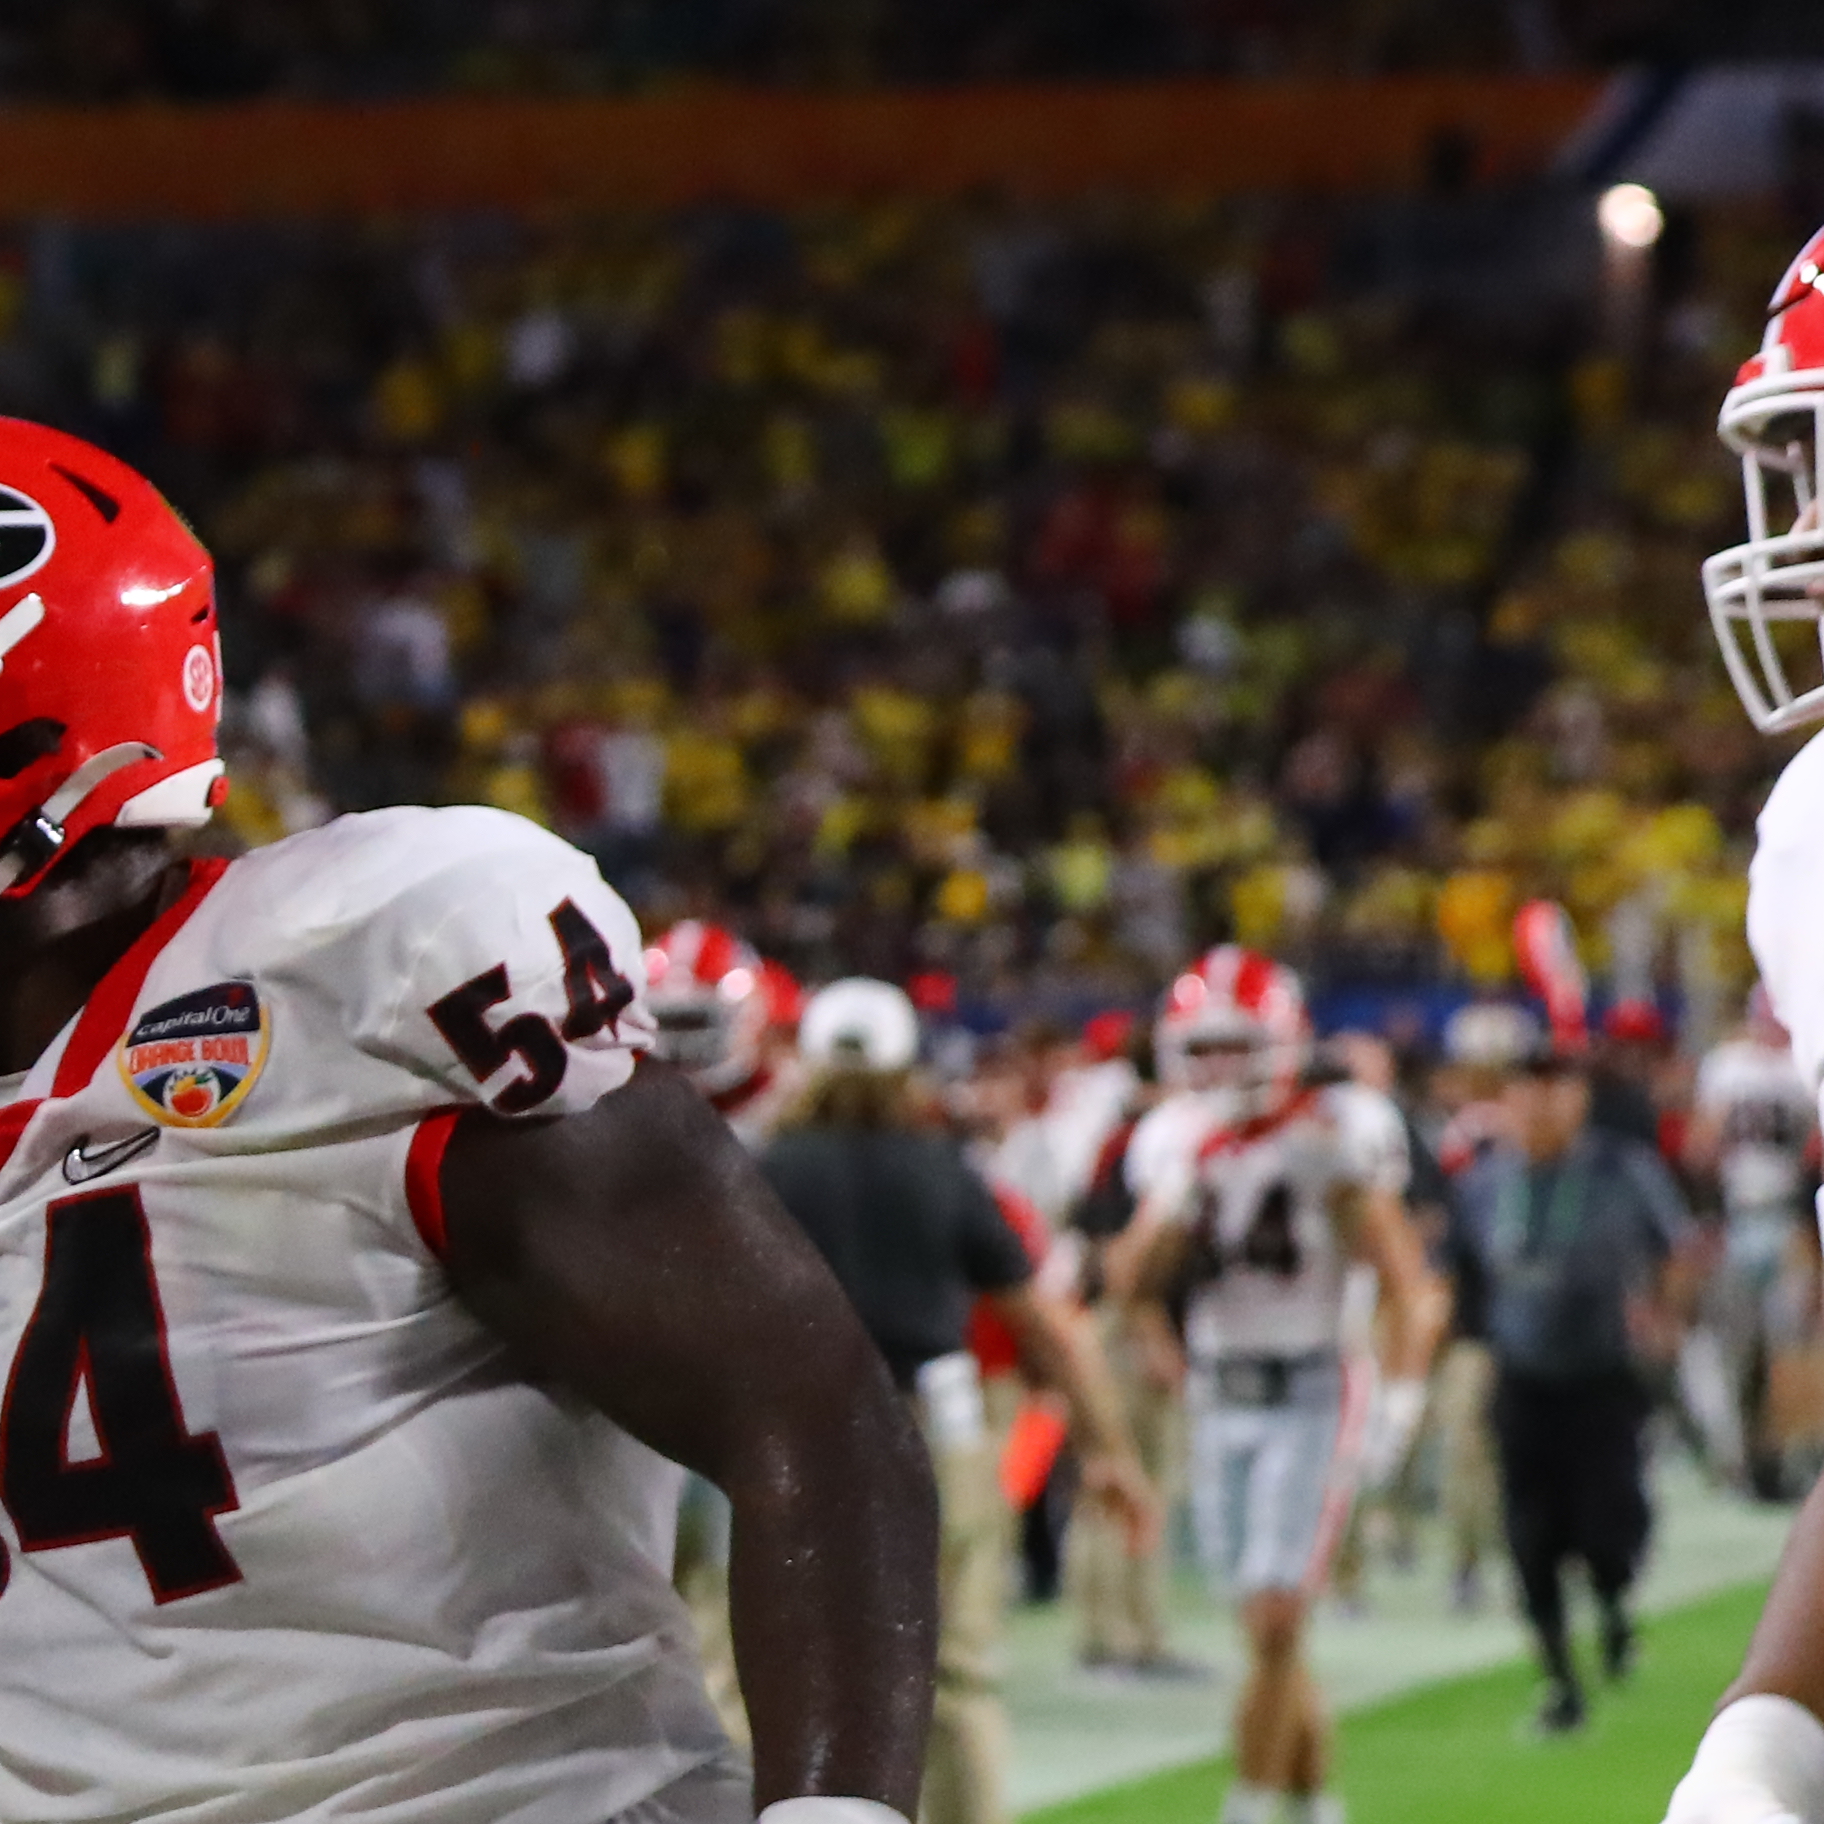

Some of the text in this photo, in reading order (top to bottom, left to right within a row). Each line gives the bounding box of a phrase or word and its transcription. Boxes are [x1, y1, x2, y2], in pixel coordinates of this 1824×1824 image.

[129, 1036, 250, 1076] ORANGE BOWL
[428, 896, 635, 1116] 54
